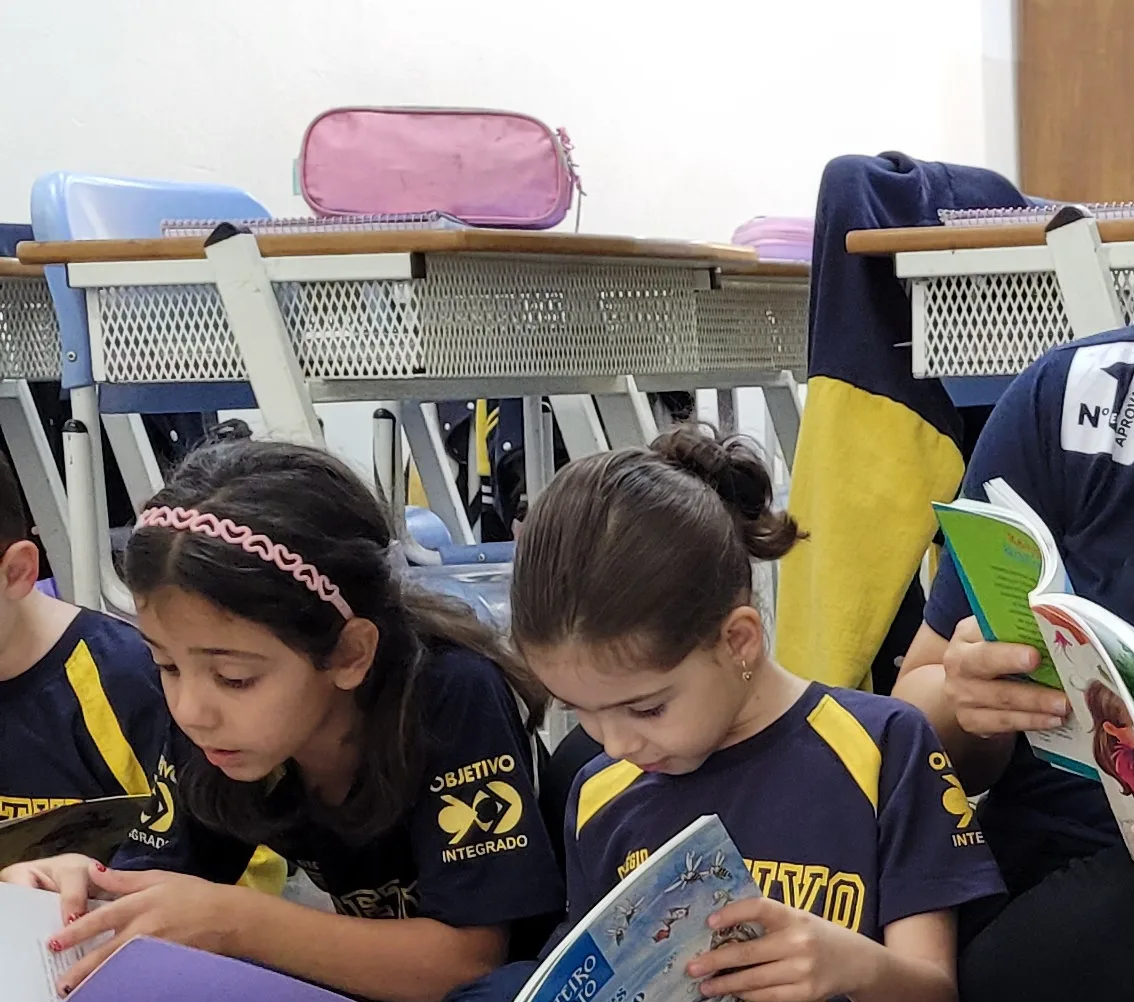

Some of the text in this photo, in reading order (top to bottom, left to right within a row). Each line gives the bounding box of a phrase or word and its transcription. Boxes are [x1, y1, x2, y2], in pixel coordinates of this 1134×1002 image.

[442, 835, 528, 863] INTEGRADO
[951, 831, 985, 848] INTE
[742, 858, 866, 933] IVO
